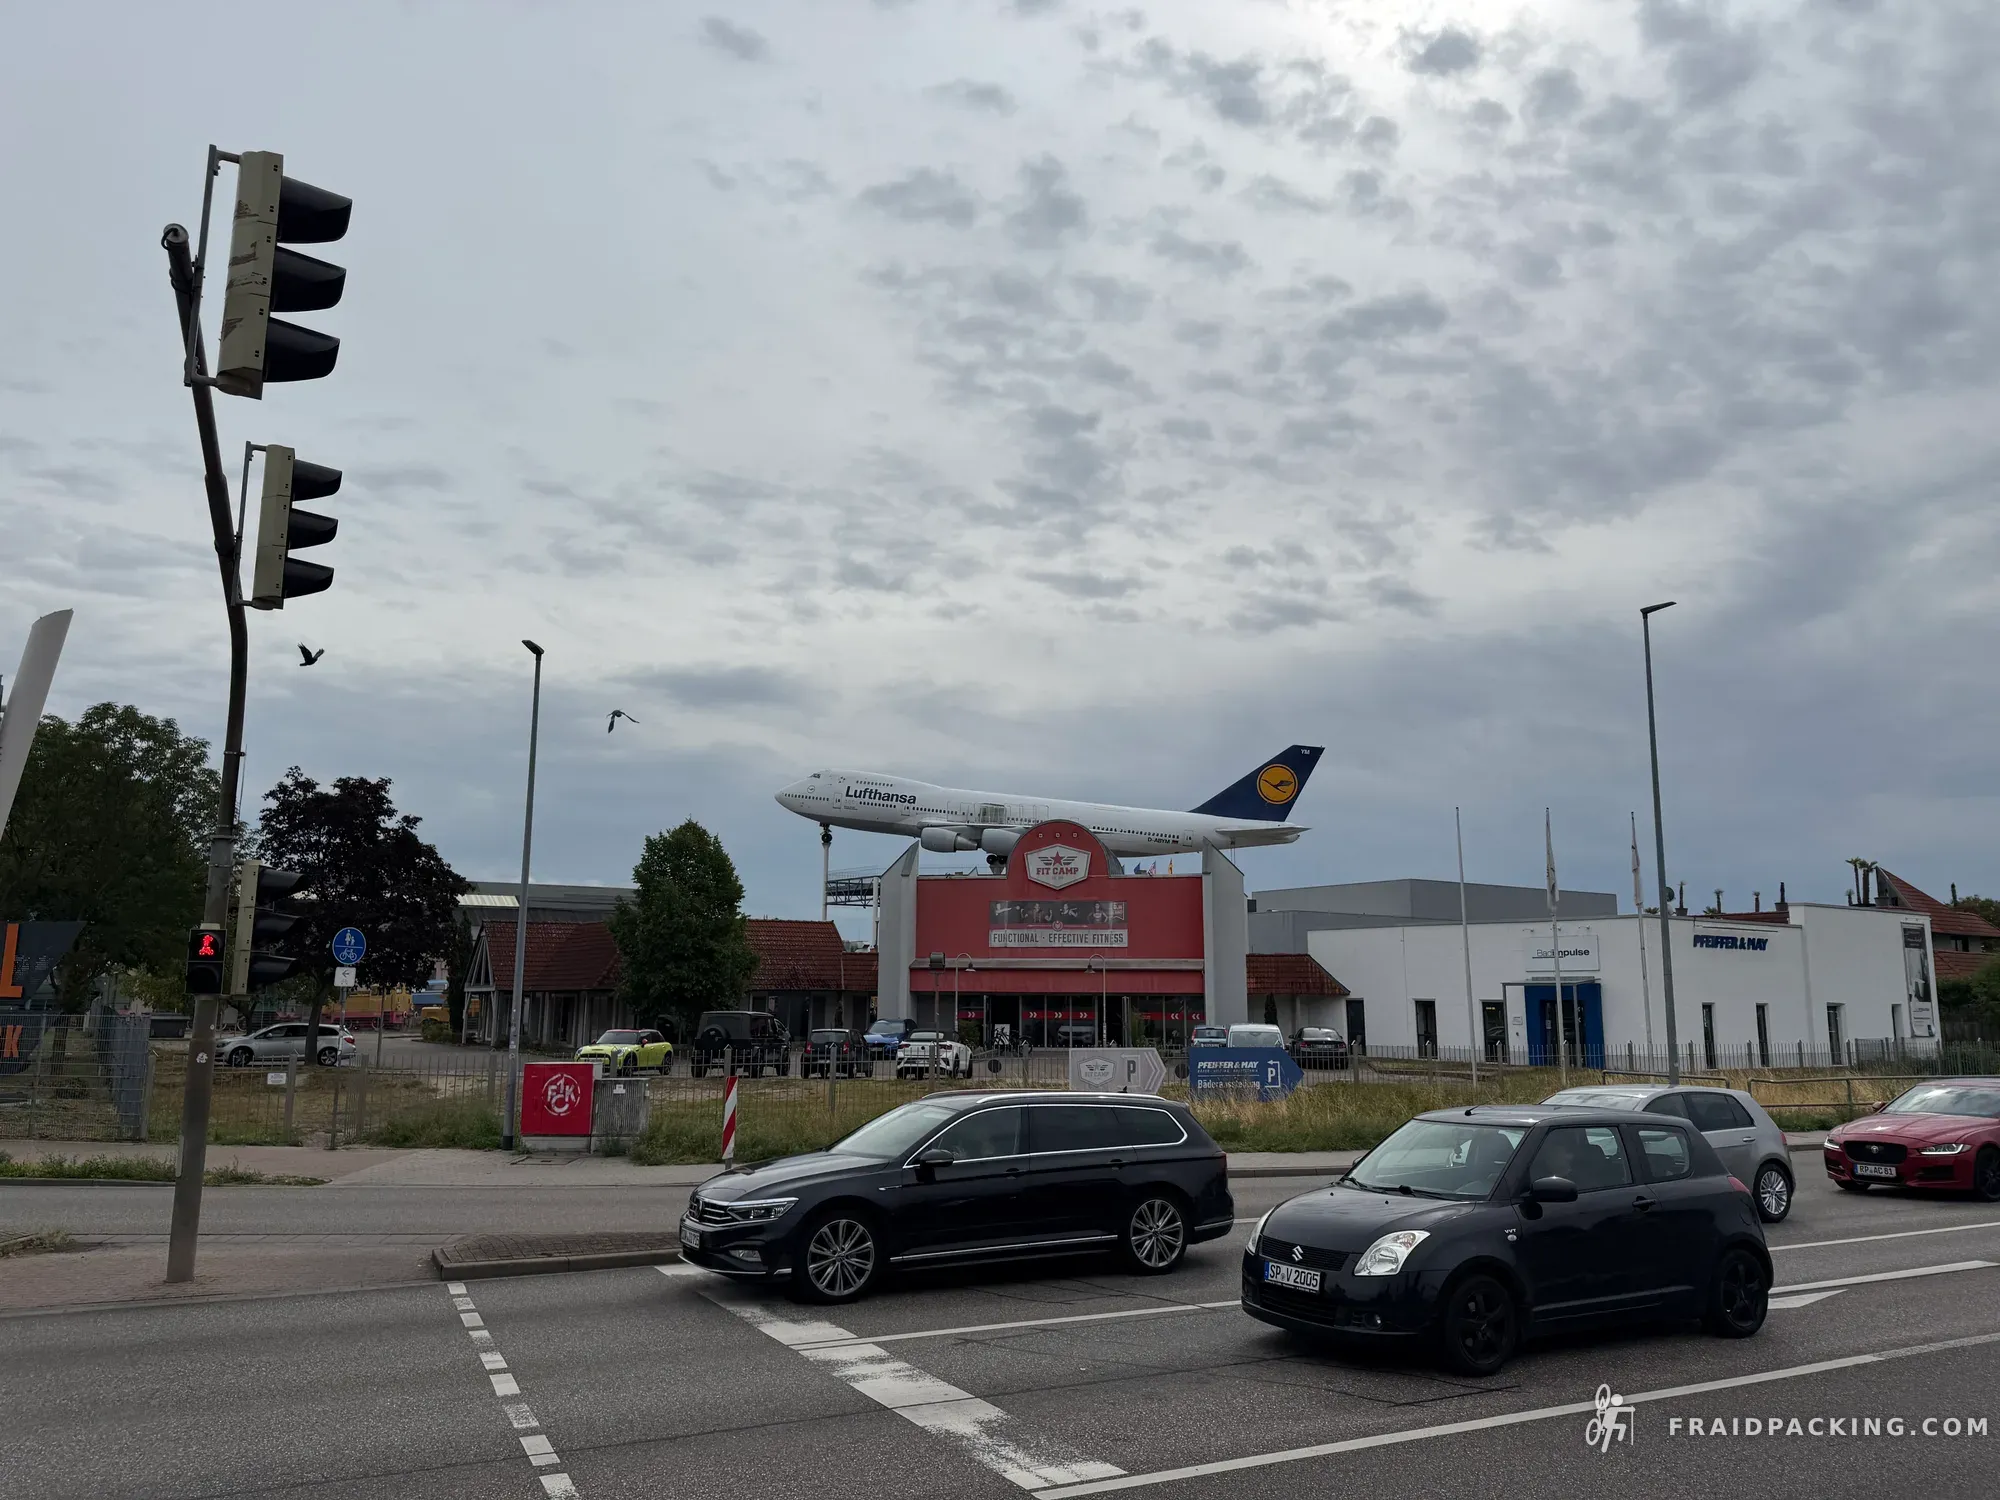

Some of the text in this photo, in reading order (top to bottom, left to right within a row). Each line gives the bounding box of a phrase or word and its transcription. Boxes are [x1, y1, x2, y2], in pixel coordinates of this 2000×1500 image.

[845, 785, 917, 805] Lufthansa
[1036, 867, 1079, 875] FIT CAMP
[993, 933, 1124, 944] FUNCTIONAL EFFECTIVE FITNESS
[1693, 934, 1769, 951] PFEIFFER & MAY
[1127, 1060, 1137, 1082] P
[1197, 1061, 1259, 1069] PFEIFFER & MAY
[1267, 1067, 1276, 1083] P
[1269, 1264, 1281, 1280] SP
[1286, 1267, 1293, 1282] V
[1293, 1269, 1319, 1288] 2005
